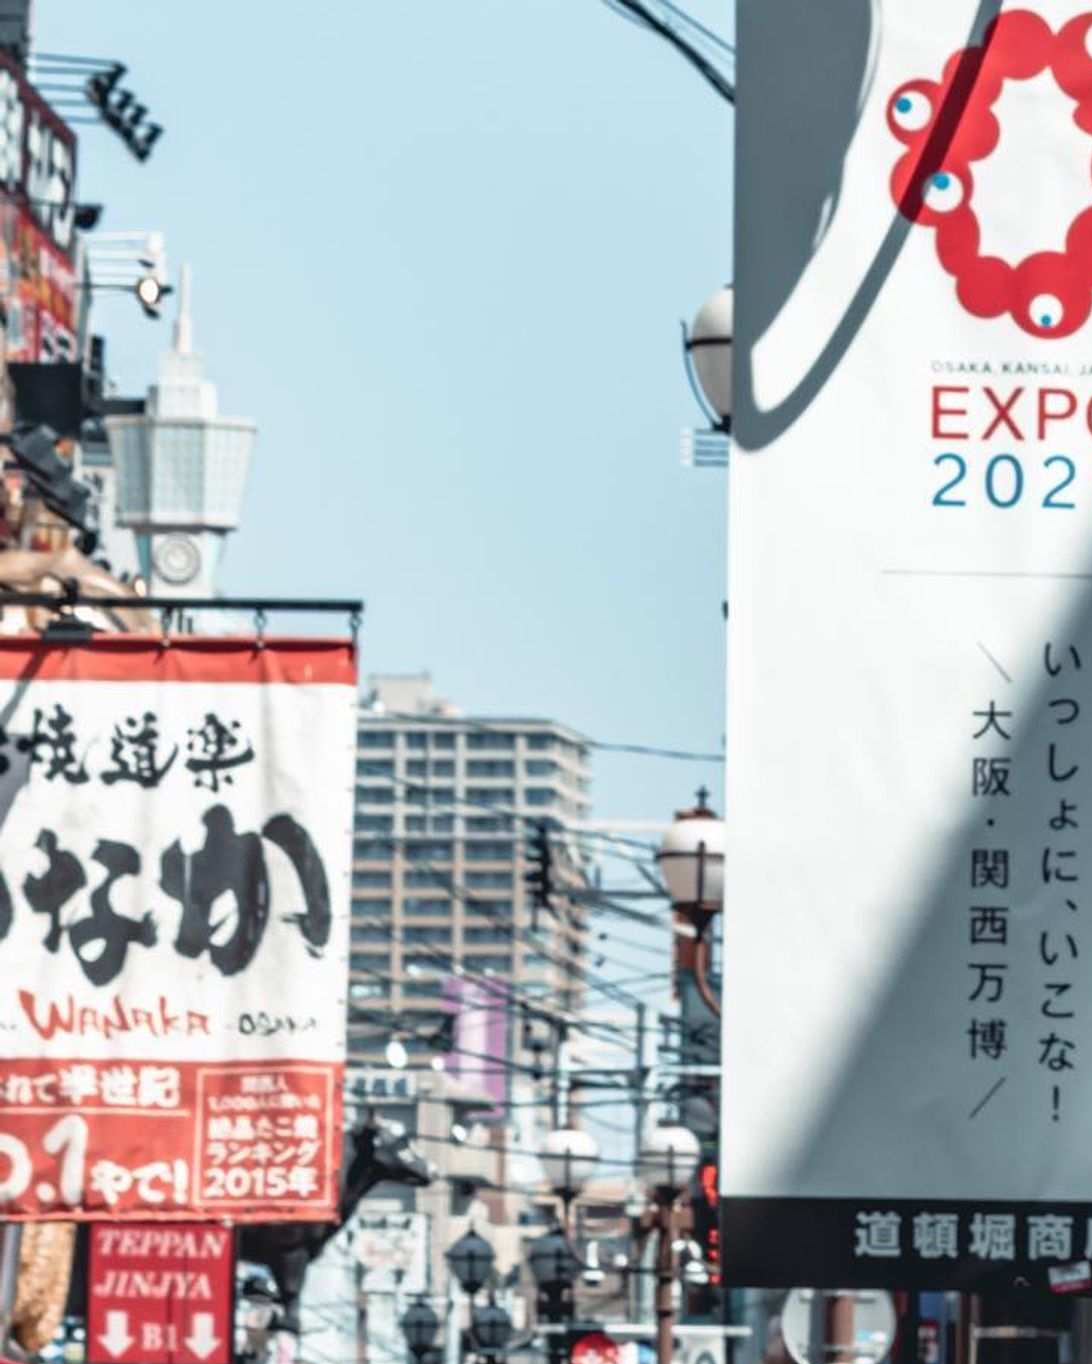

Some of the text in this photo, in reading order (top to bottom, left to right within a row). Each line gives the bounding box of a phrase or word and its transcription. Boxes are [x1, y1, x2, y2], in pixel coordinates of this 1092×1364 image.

[0, 803, 332, 987] なか
[0, 1064, 180, 1108] れて半世紀
[206, 1140, 321, 1165] ランキング
[203, 1166, 318, 1198] 2015年
[98, 1229, 228, 1258] TEPPAN
[93, 1269, 212, 1299] JINJYA
[141, 1322, 178, 1351] B1
